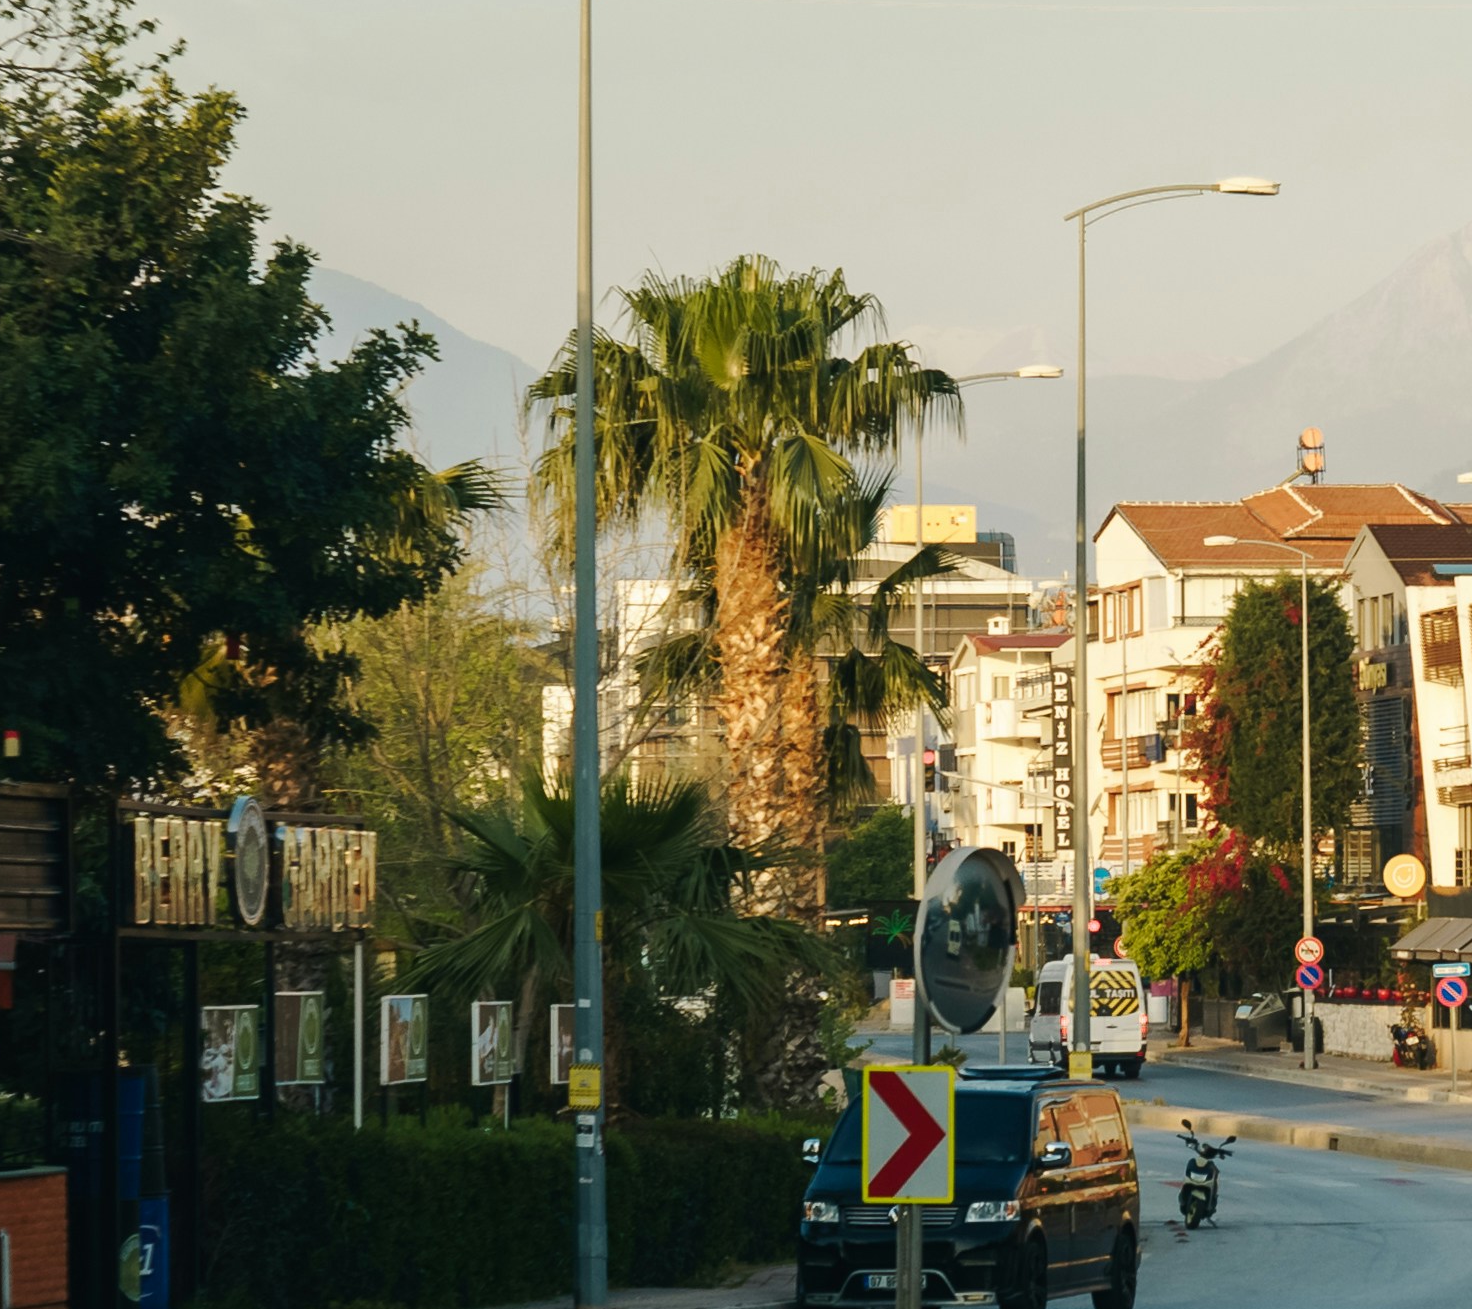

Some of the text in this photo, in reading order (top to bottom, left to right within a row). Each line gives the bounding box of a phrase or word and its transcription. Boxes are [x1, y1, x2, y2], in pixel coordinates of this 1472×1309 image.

[1055, 767, 1071, 848] HOTEL
[134, 817, 376, 933] BERRY GARDEN
